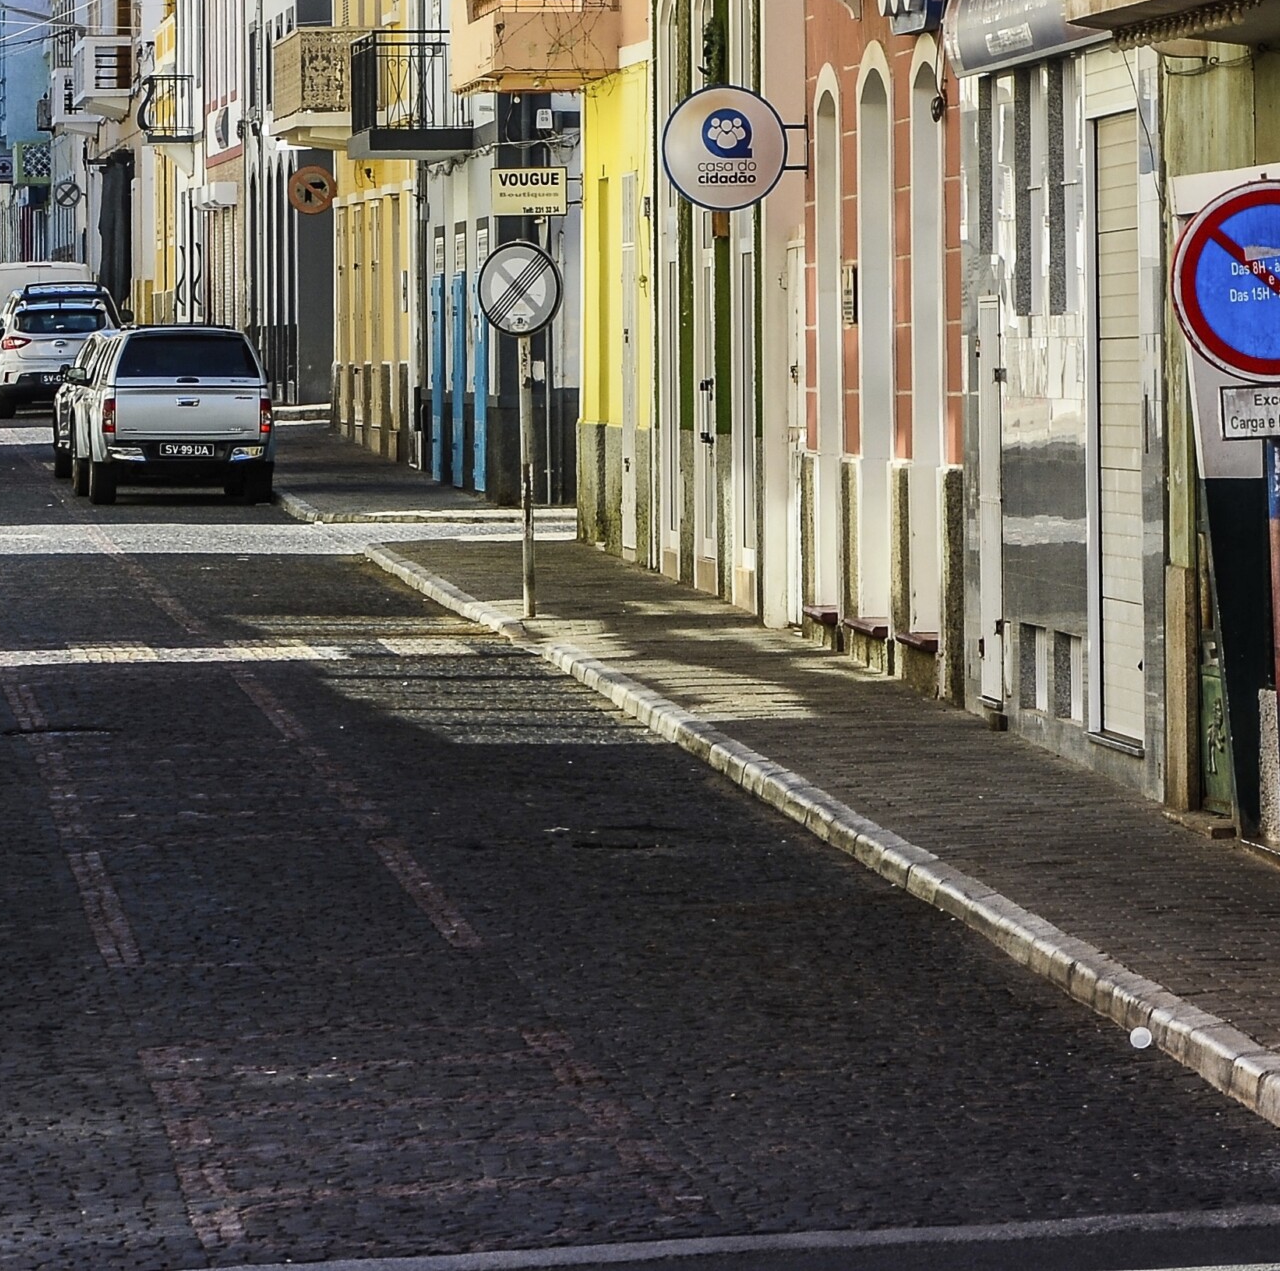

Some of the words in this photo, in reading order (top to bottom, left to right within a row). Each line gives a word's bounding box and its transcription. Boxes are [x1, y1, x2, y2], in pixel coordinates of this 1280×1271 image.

[698, 161, 733, 172] casa
[738, 159, 757, 172] do
[499, 172, 560, 187] VOUGUE
[698, 171, 757, 184] cidadão
[1231, 262, 1250, 276] Das
[1252, 260, 1266, 275] 8H
[1268, 275, 1275, 285] e
[1229, 288, 1249, 302] Das
[1251, 287, 1270, 301] 15H
[1230, 415, 1266, 433] Carga
[1268, 417, 1276, 429] e
